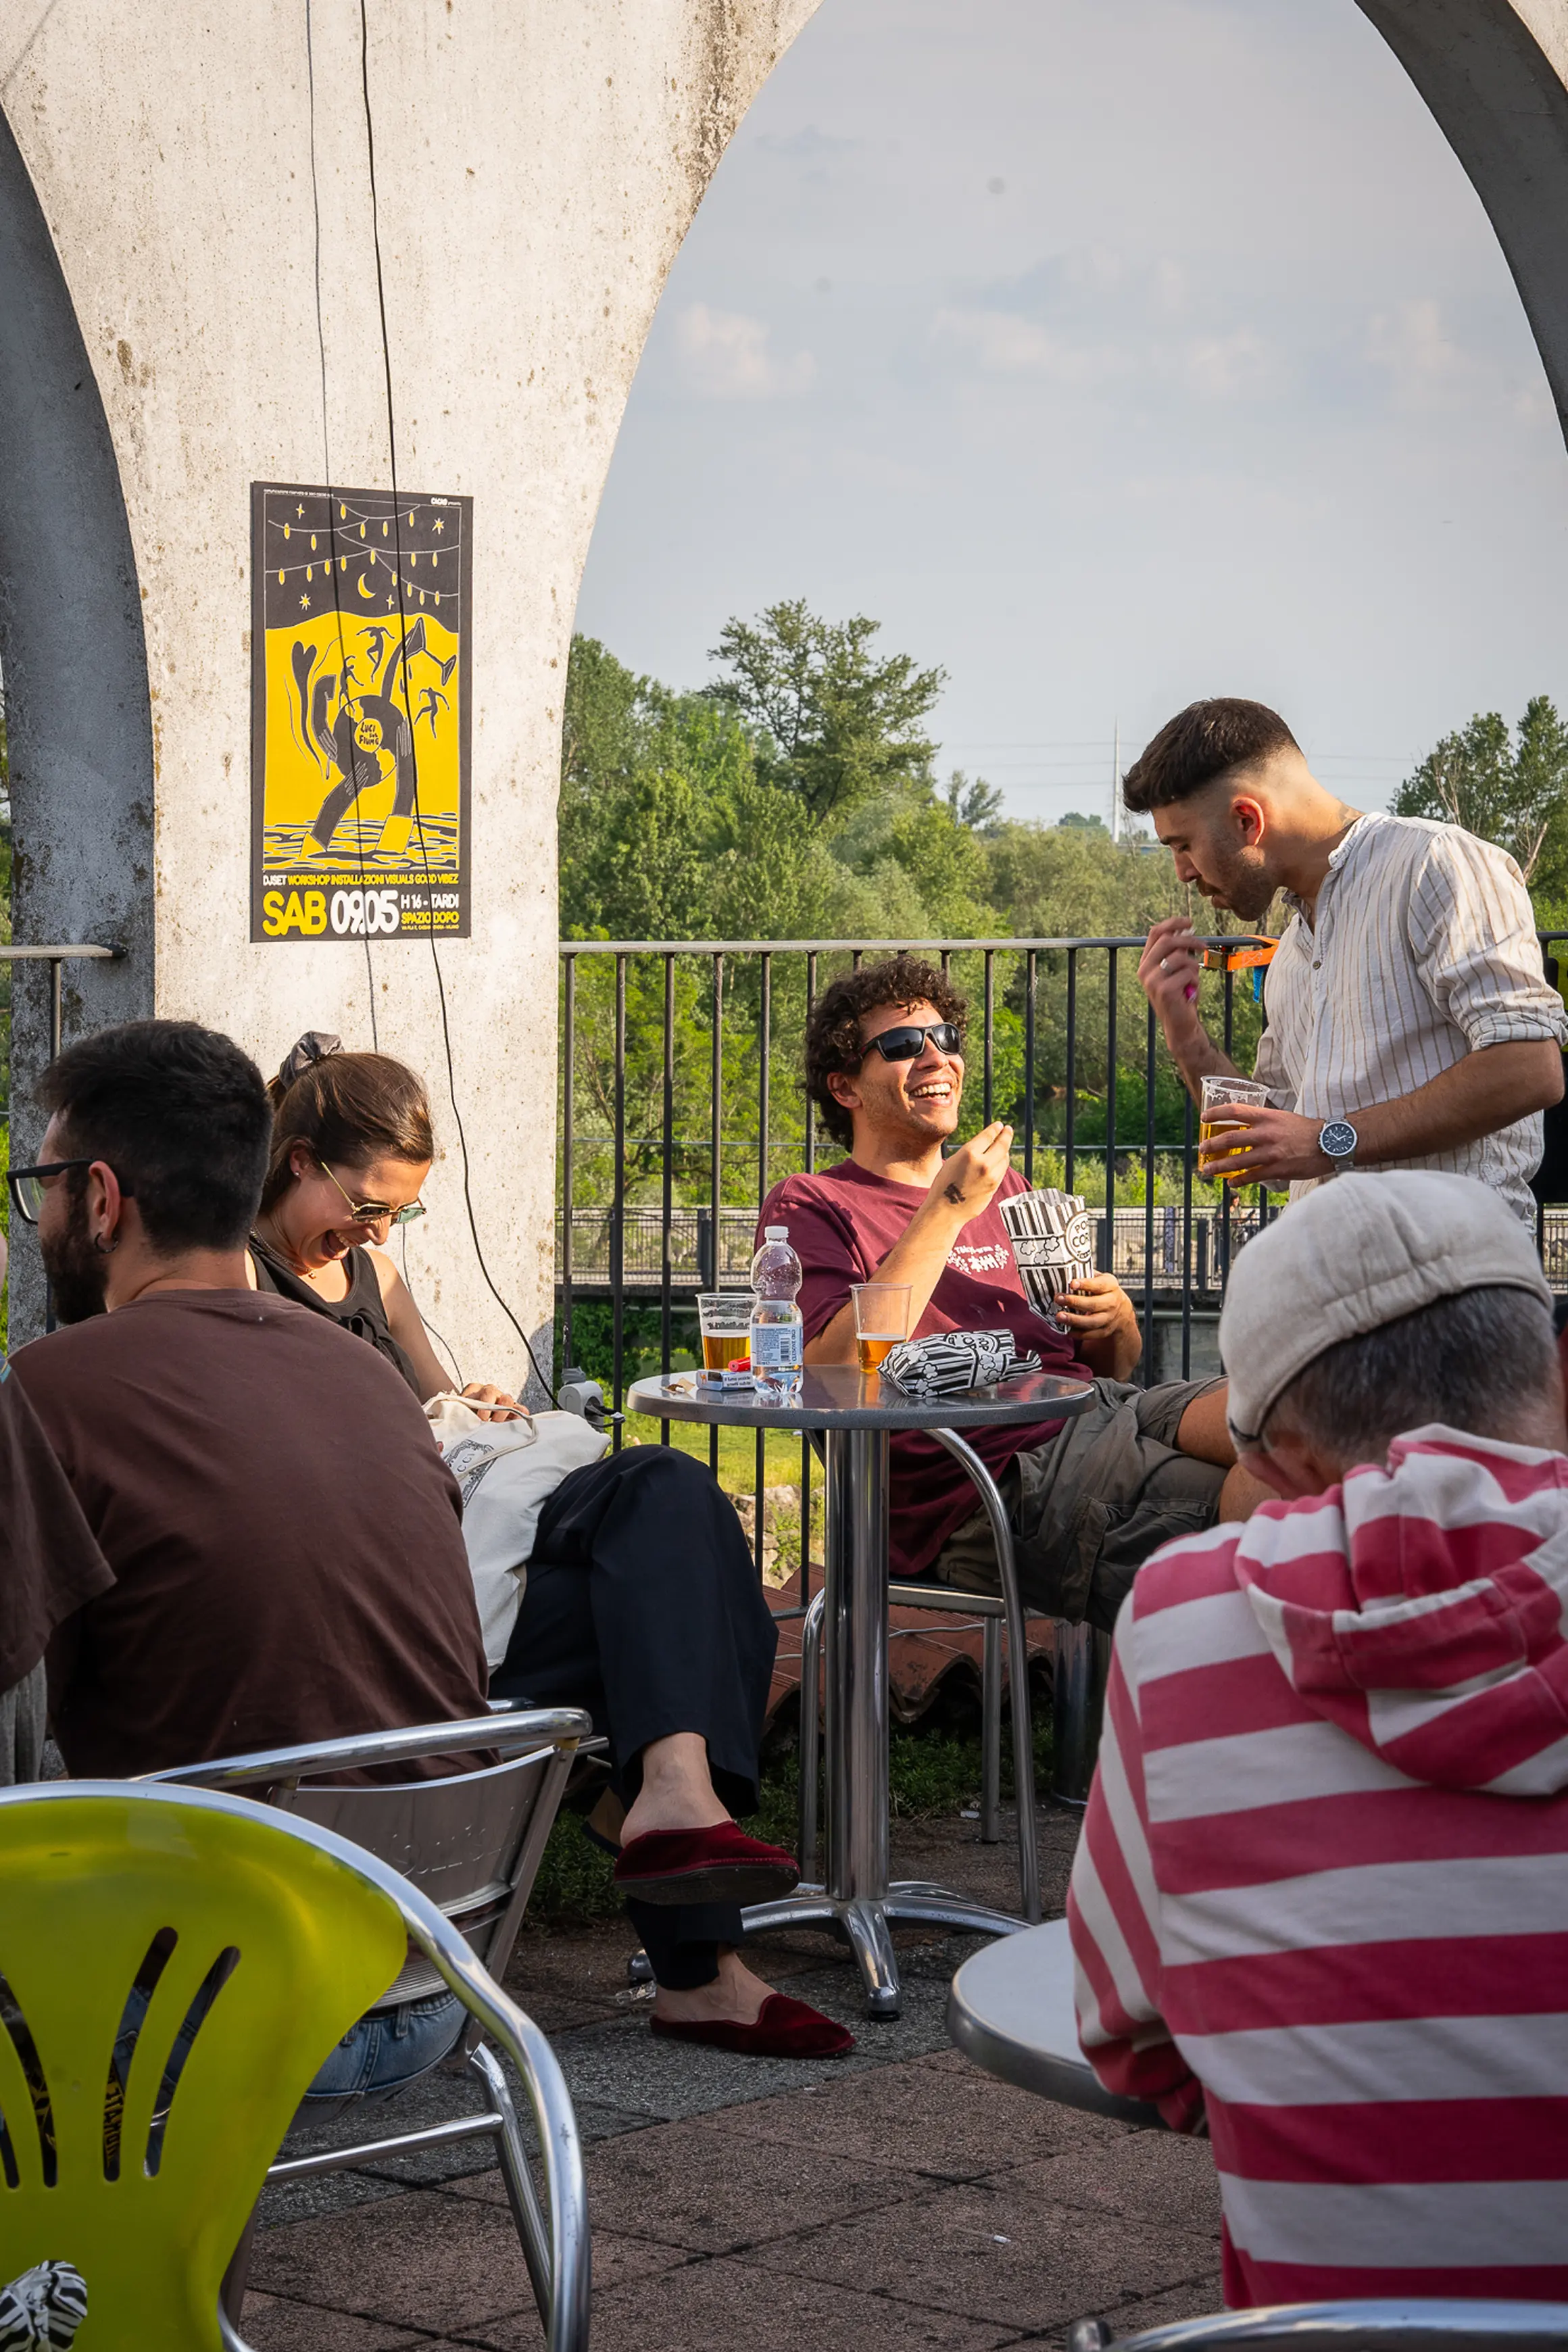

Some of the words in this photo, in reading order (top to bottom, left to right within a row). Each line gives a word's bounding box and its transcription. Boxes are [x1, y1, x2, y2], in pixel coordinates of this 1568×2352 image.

[360, 721, 376, 733] LUCI
[263, 875, 287, 885] DJSET
[287, 875, 330, 885] WORKSHOP
[385, 874, 414, 885] VISUALS
[437, 873, 459, 884] VIBEZ
[401, 894, 410, 909] H
[411, 893, 422, 909] 16
[431, 893, 460, 908] TARDI
[262, 890, 328, 936] SAB
[401, 911, 432, 924] SPAZIO
[433, 910, 460, 924] DOPO
[1075, 1219, 1088, 1233] PO
